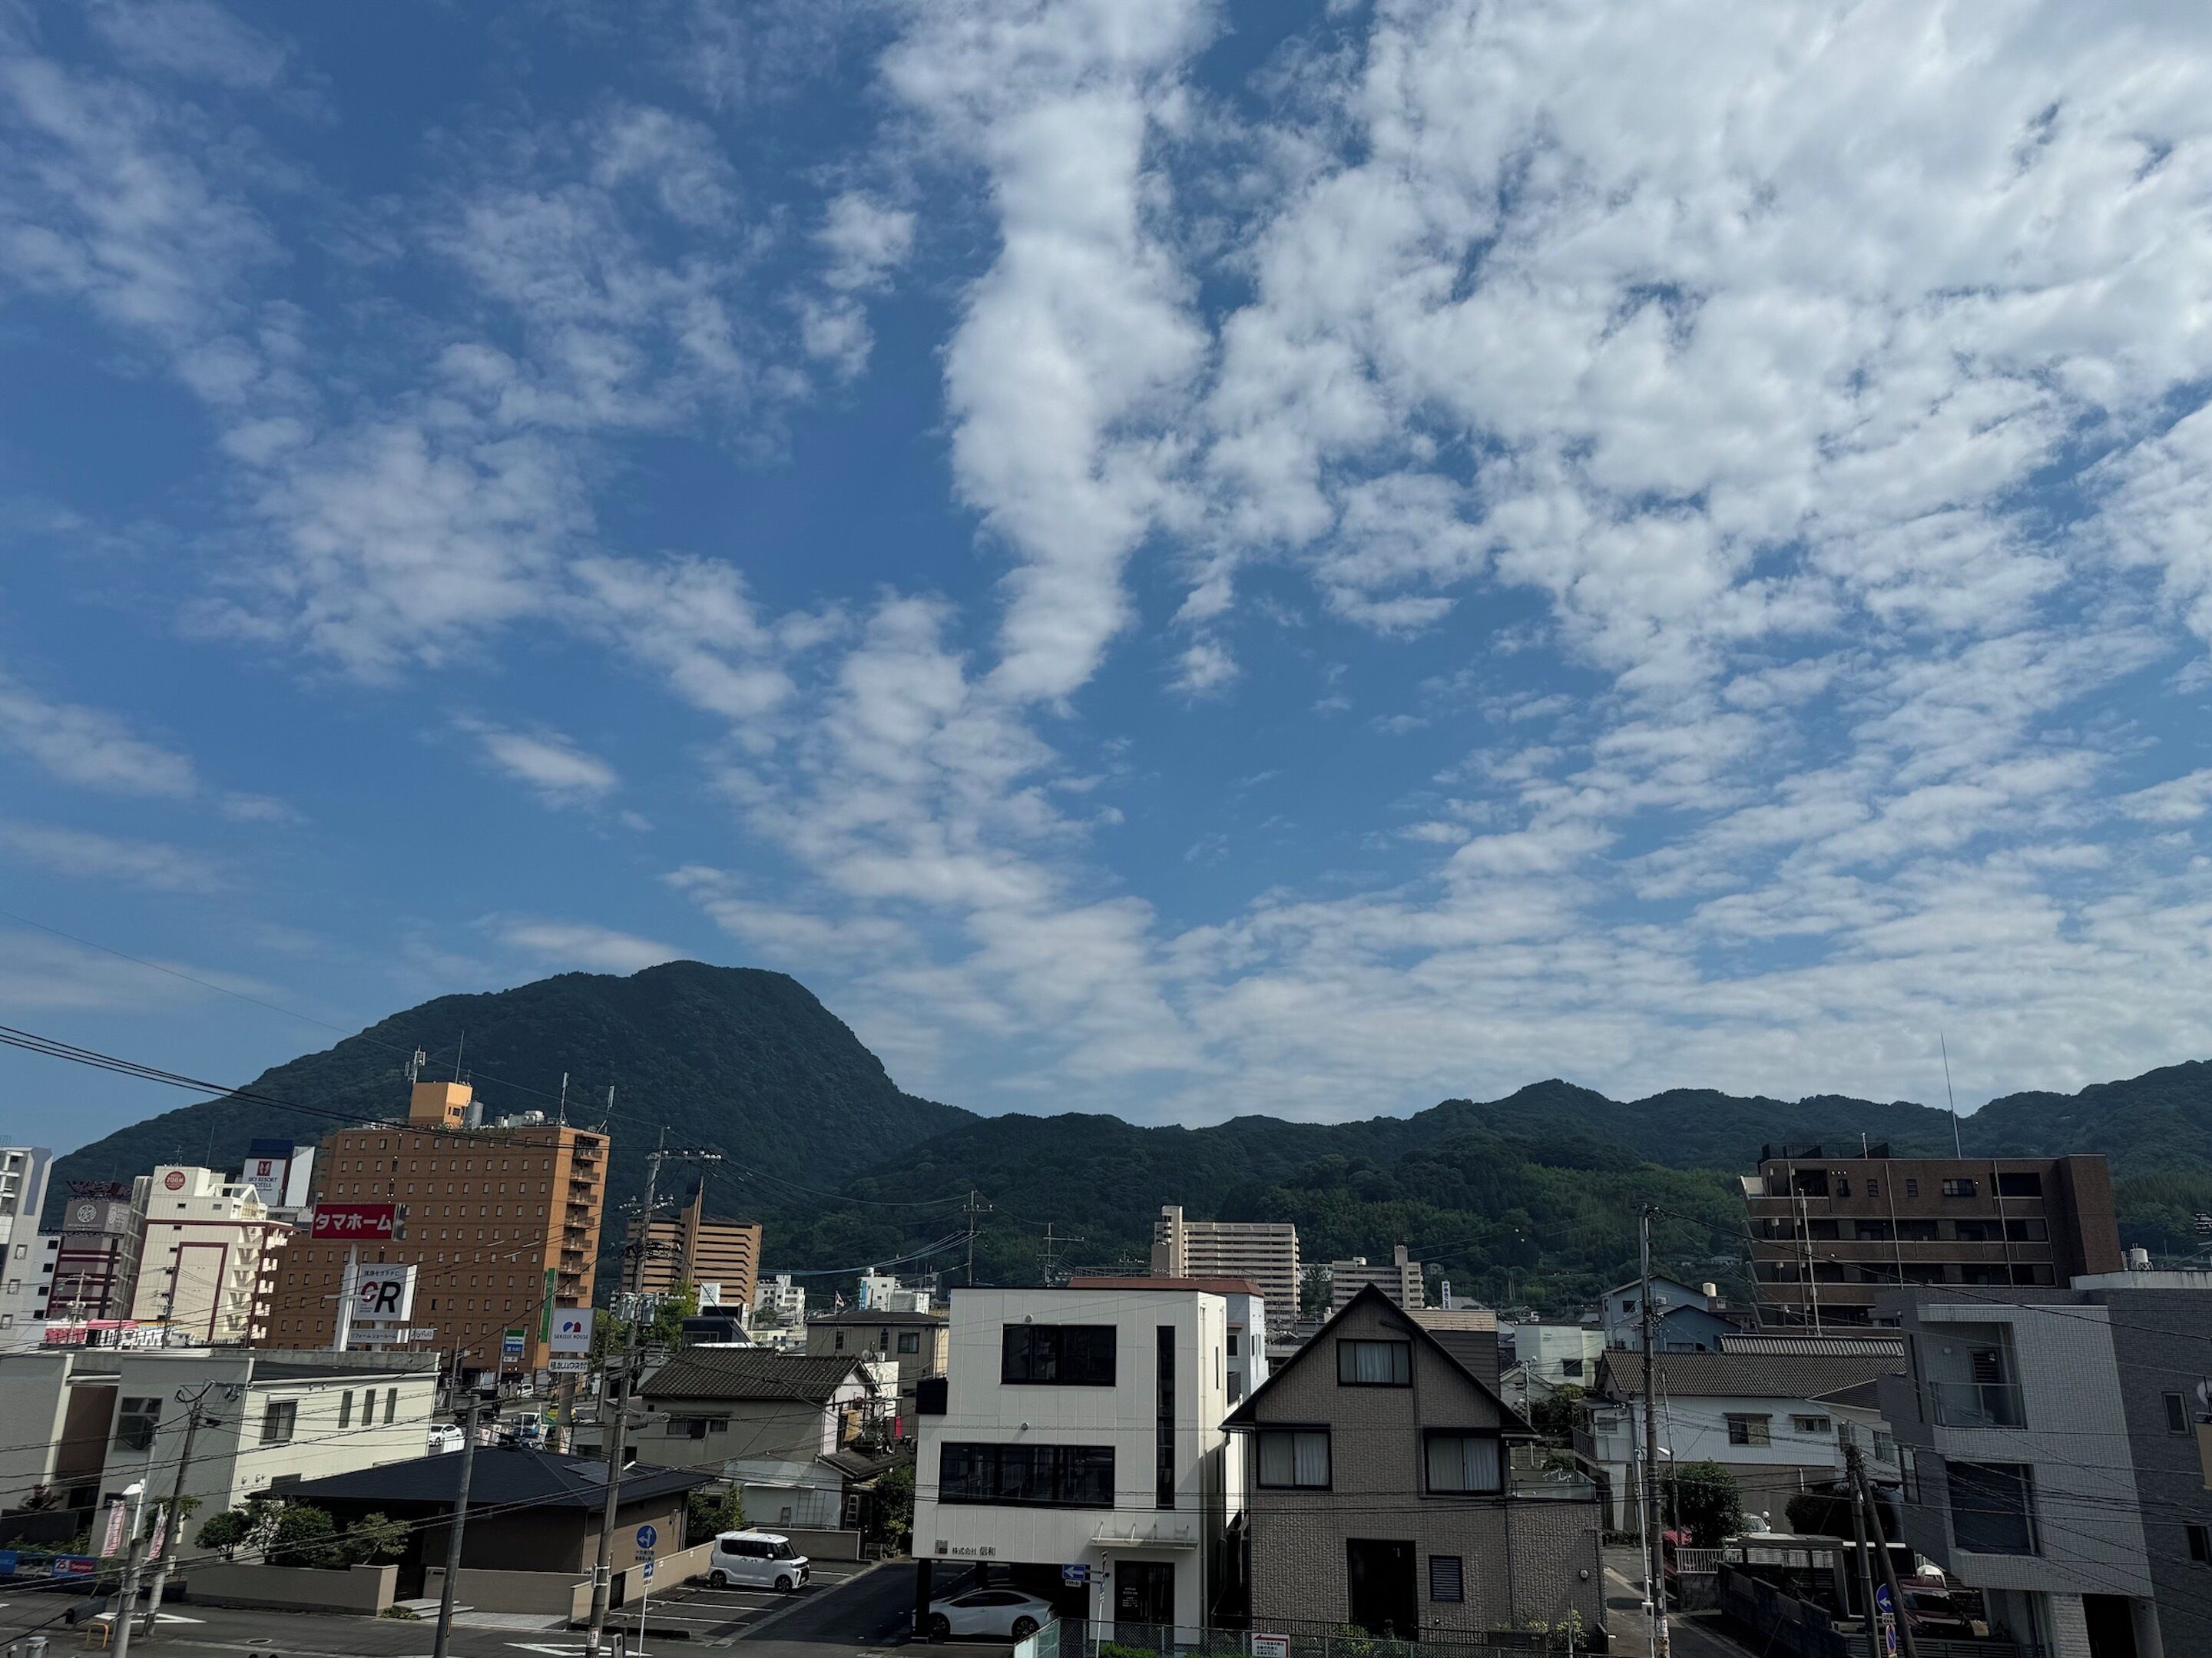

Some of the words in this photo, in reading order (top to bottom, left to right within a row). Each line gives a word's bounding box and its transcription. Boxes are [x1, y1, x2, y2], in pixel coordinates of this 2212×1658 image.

[315, 1213, 392, 1230] タマホーム
[952, 1547, 977, 1555] 株式会社
[979, 1546, 996, 1556] 信和
